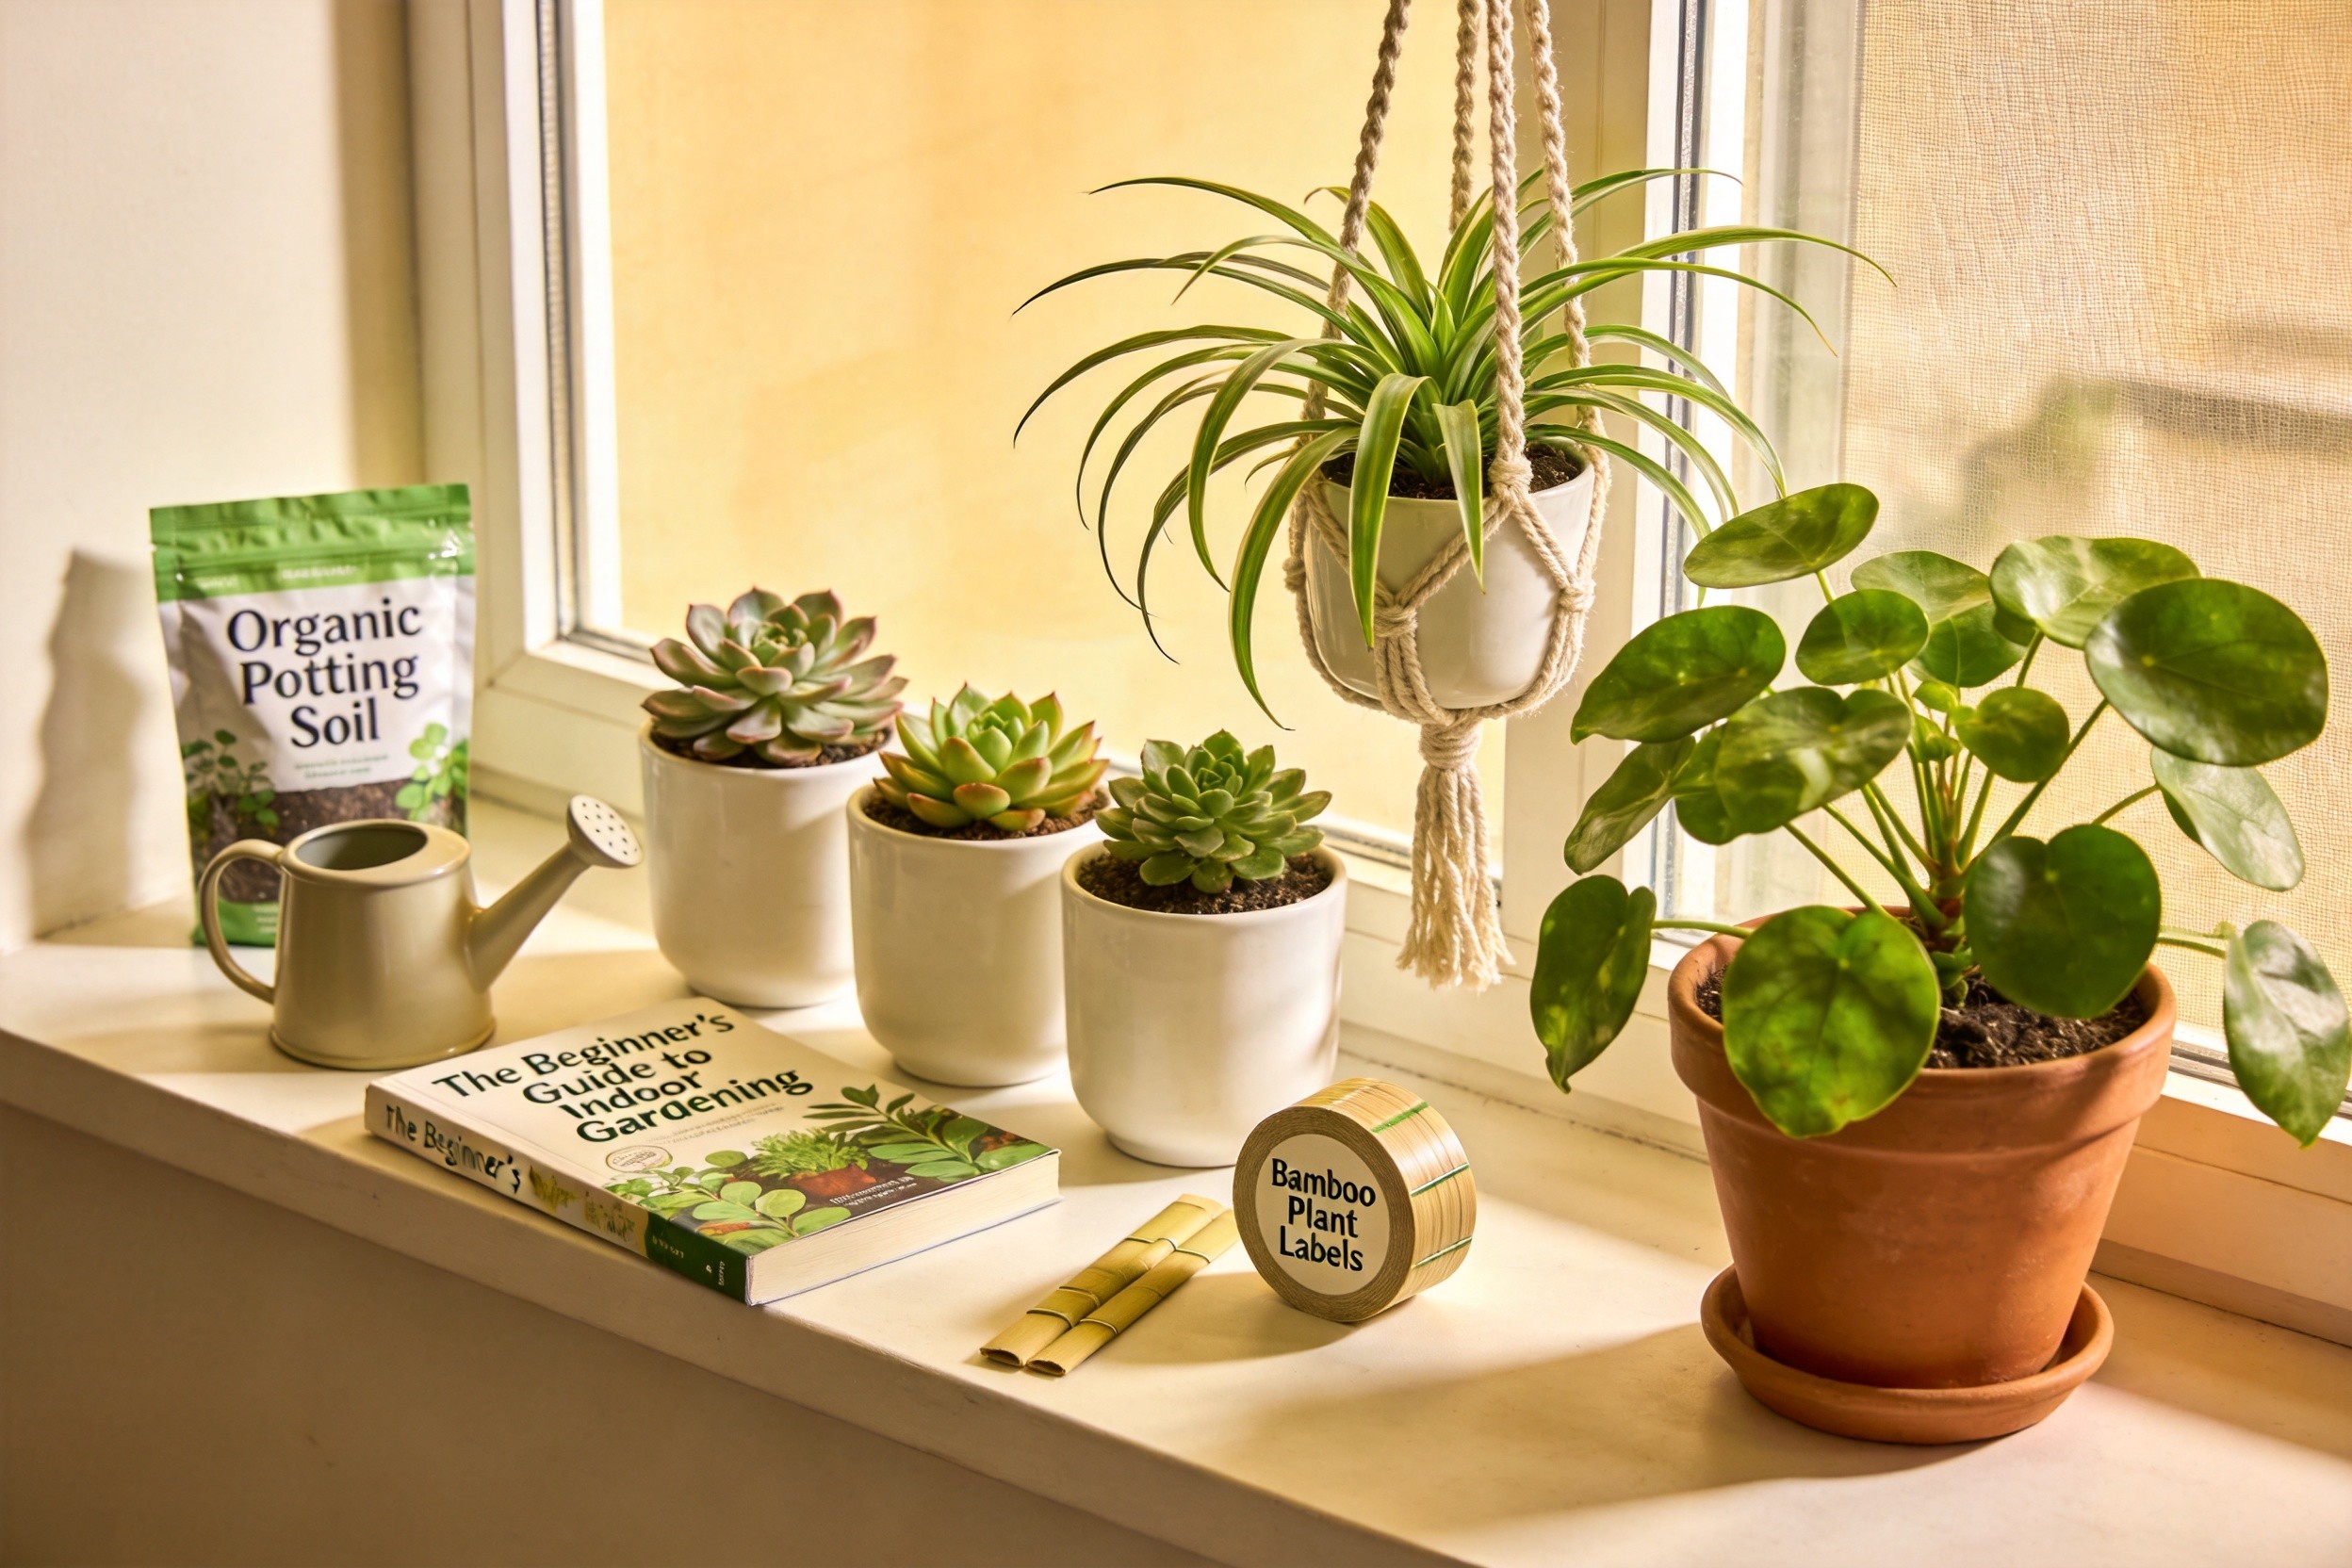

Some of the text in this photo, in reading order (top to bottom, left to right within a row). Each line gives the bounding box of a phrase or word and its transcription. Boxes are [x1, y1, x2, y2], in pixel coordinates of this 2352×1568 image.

[227, 596, 423, 657] Organic
[240, 653, 418, 706] Potting
[290, 695, 381, 748] Soil
[432, 1013, 736, 1098] The Beginner's
[522, 1049, 712, 1104] Guide to
[559, 1072, 701, 1119] Indoor
[576, 1069, 814, 1143] Gardening
[1271, 1157, 1377, 1207] Bamboo
[1288, 1195, 1359, 1238] Plant
[1280, 1225, 1364, 1272] Labels
